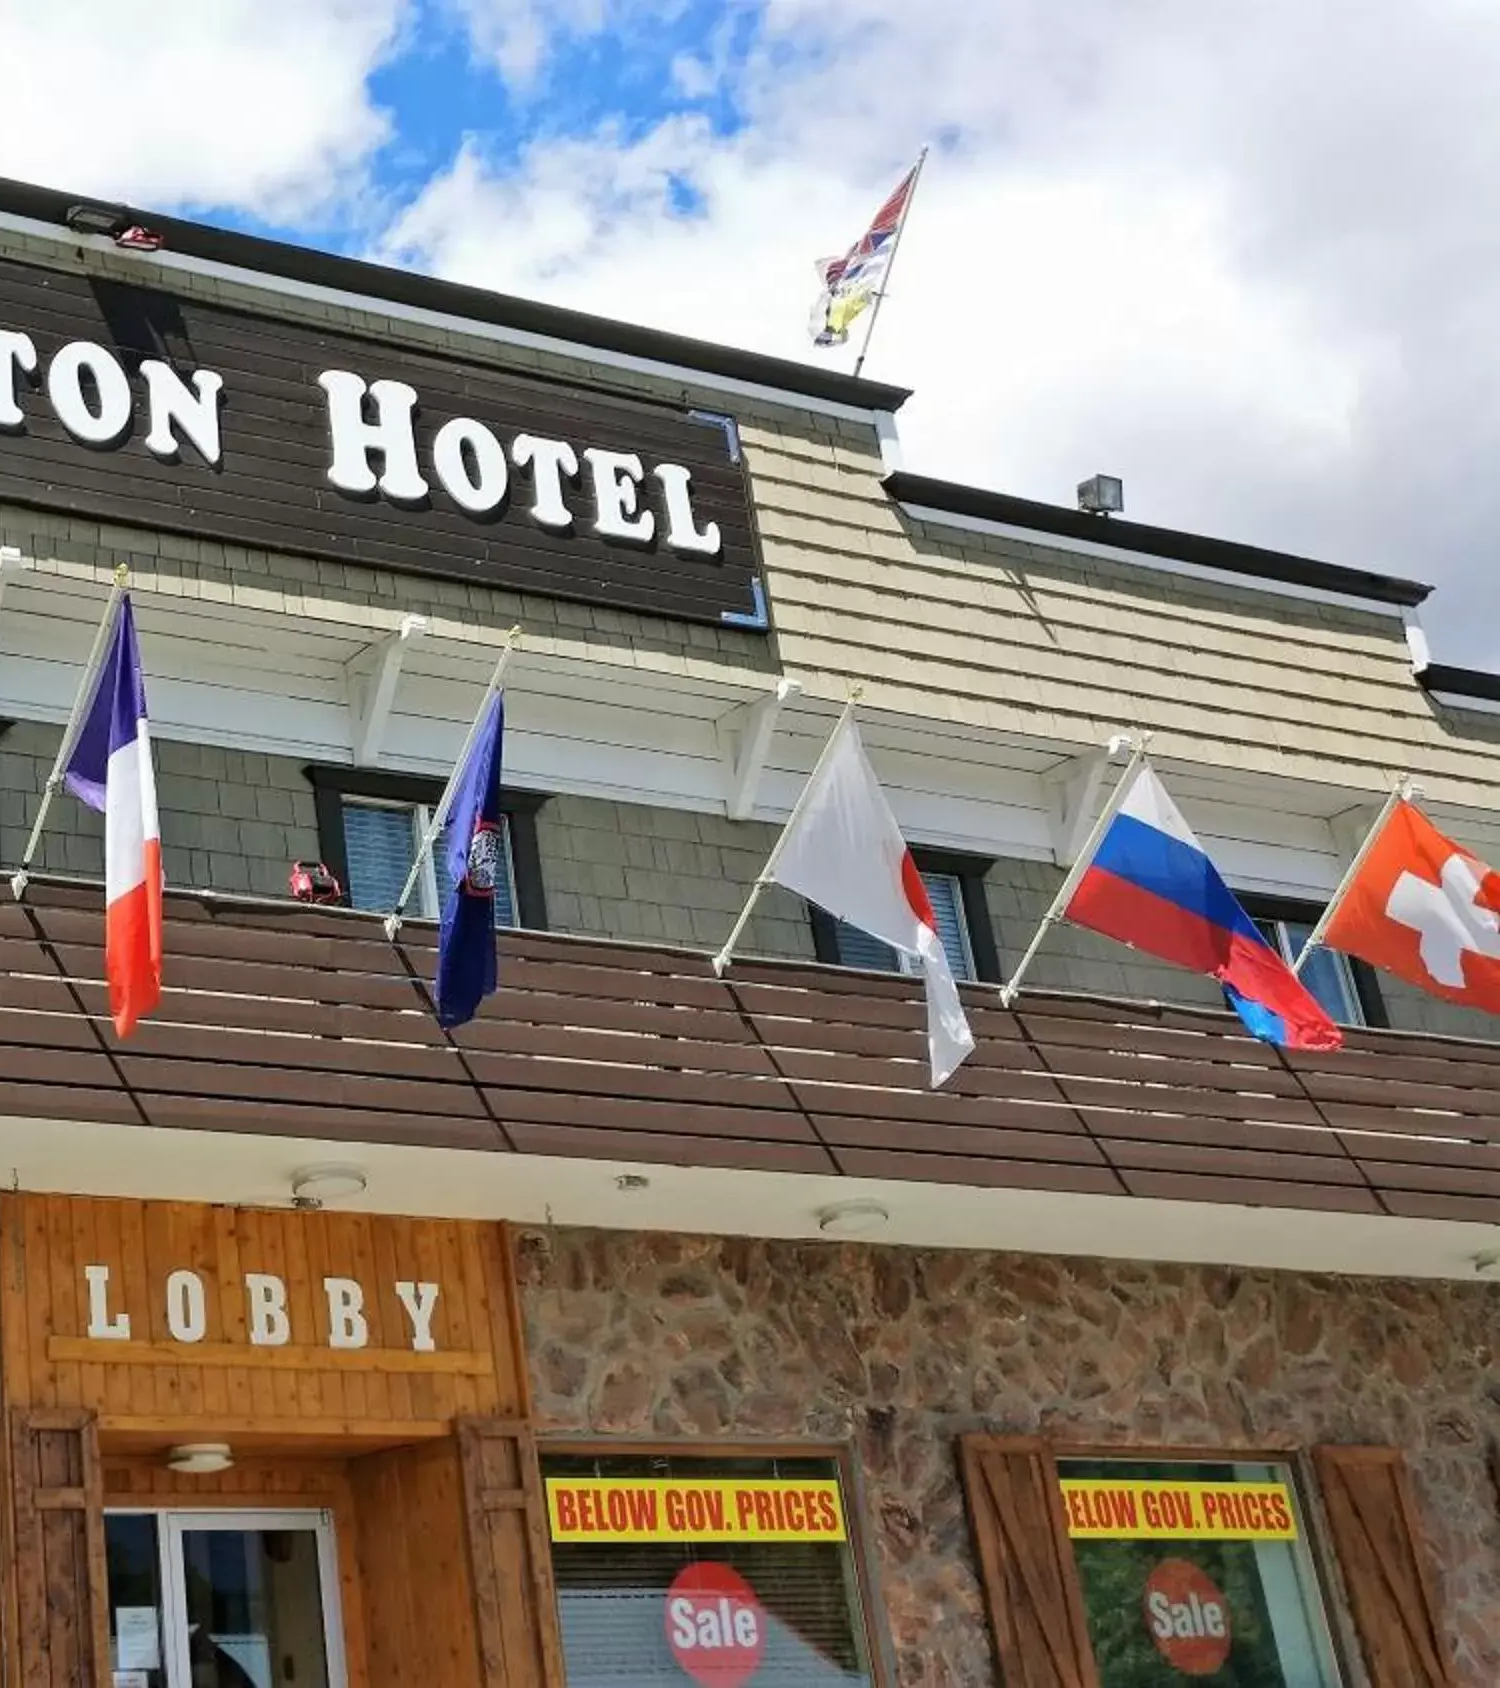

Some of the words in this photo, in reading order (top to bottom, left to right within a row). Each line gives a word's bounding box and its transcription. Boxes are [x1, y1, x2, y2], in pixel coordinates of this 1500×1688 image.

[318, 370, 721, 555] HOTEL
[85, 1265, 439, 1352] LOBBY
[555, 1489, 658, 1532] BELOW
[665, 1489, 732, 1532] GOV.
[735, 1490, 839, 1532] PRICES
[1141, 1490, 1200, 1530] GOV.
[1201, 1491, 1291, 1531] PRICES
[669, 1597, 759, 1649] Sale
[1148, 1591, 1226, 1639] Sale
